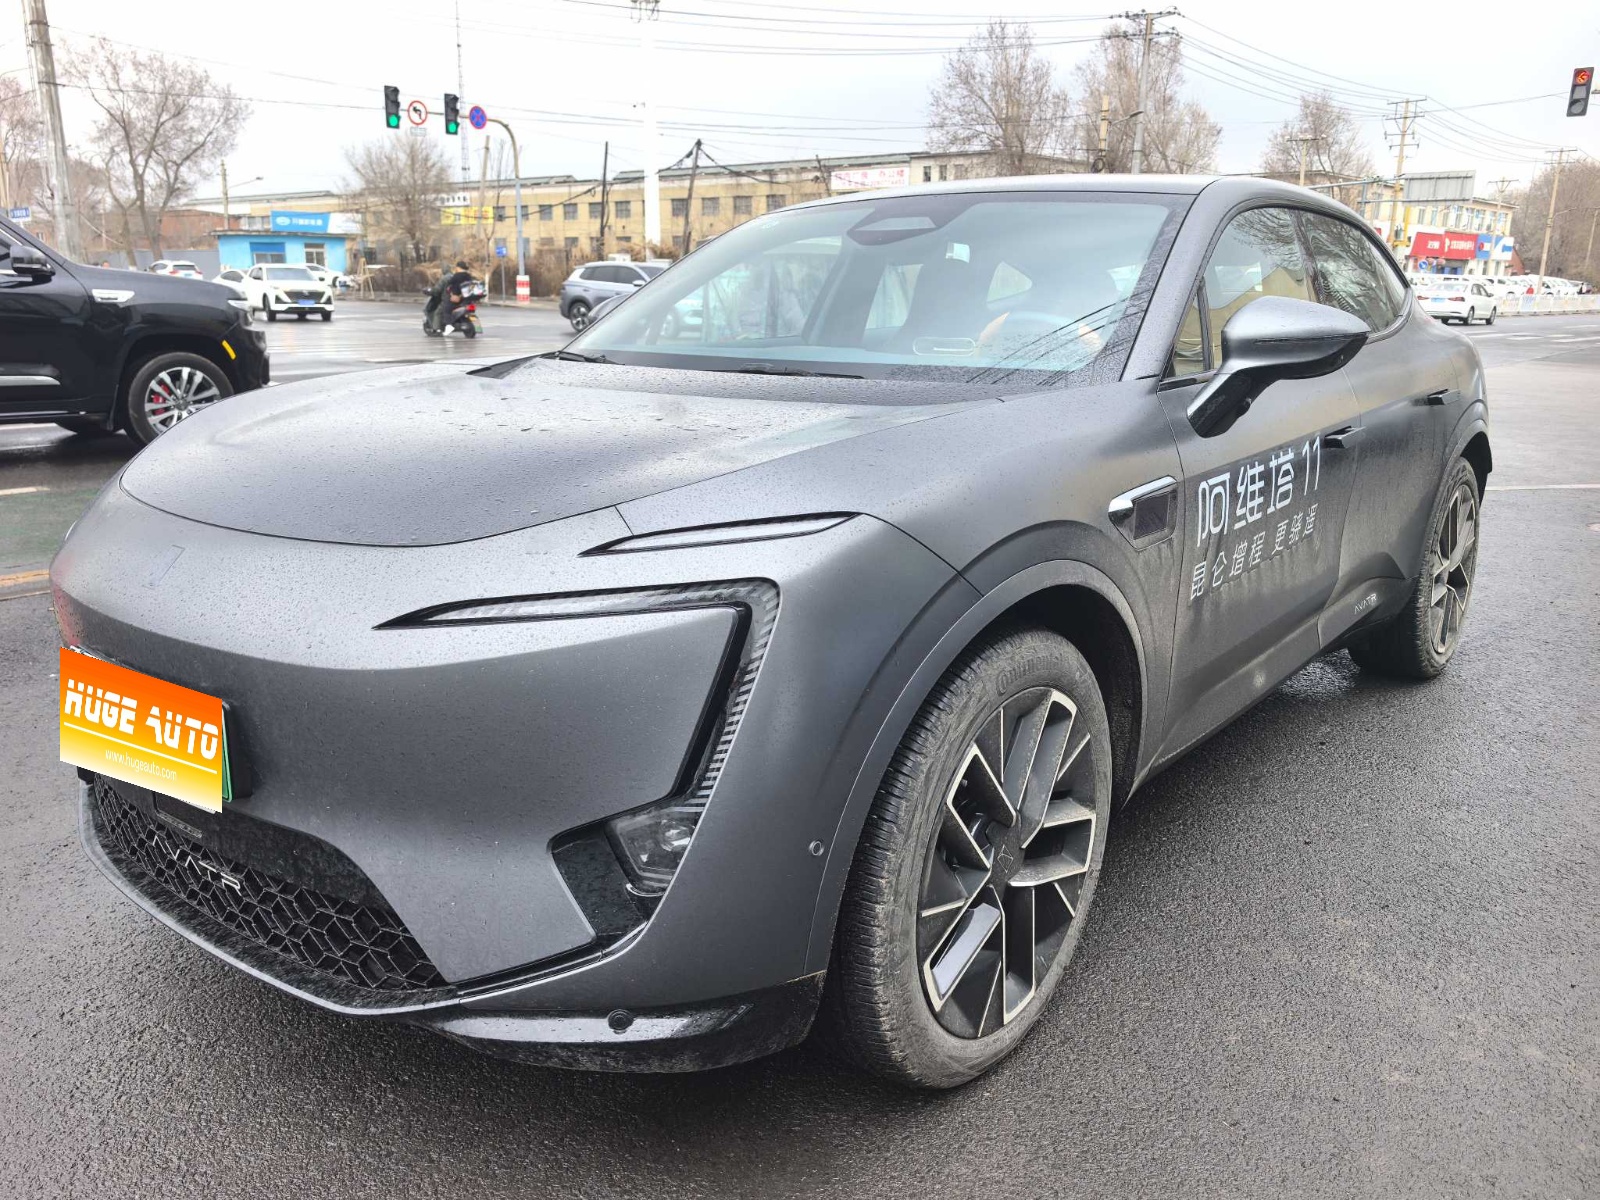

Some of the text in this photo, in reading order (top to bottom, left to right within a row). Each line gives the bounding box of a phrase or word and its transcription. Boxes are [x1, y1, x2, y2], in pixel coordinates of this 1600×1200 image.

[1197, 436, 1321, 547] 阿维塔 11
[1190, 531, 1266, 600] 昆仑增程
[1354, 593, 1377, 614] AVATR
[152, 834, 242, 897] AVATR
